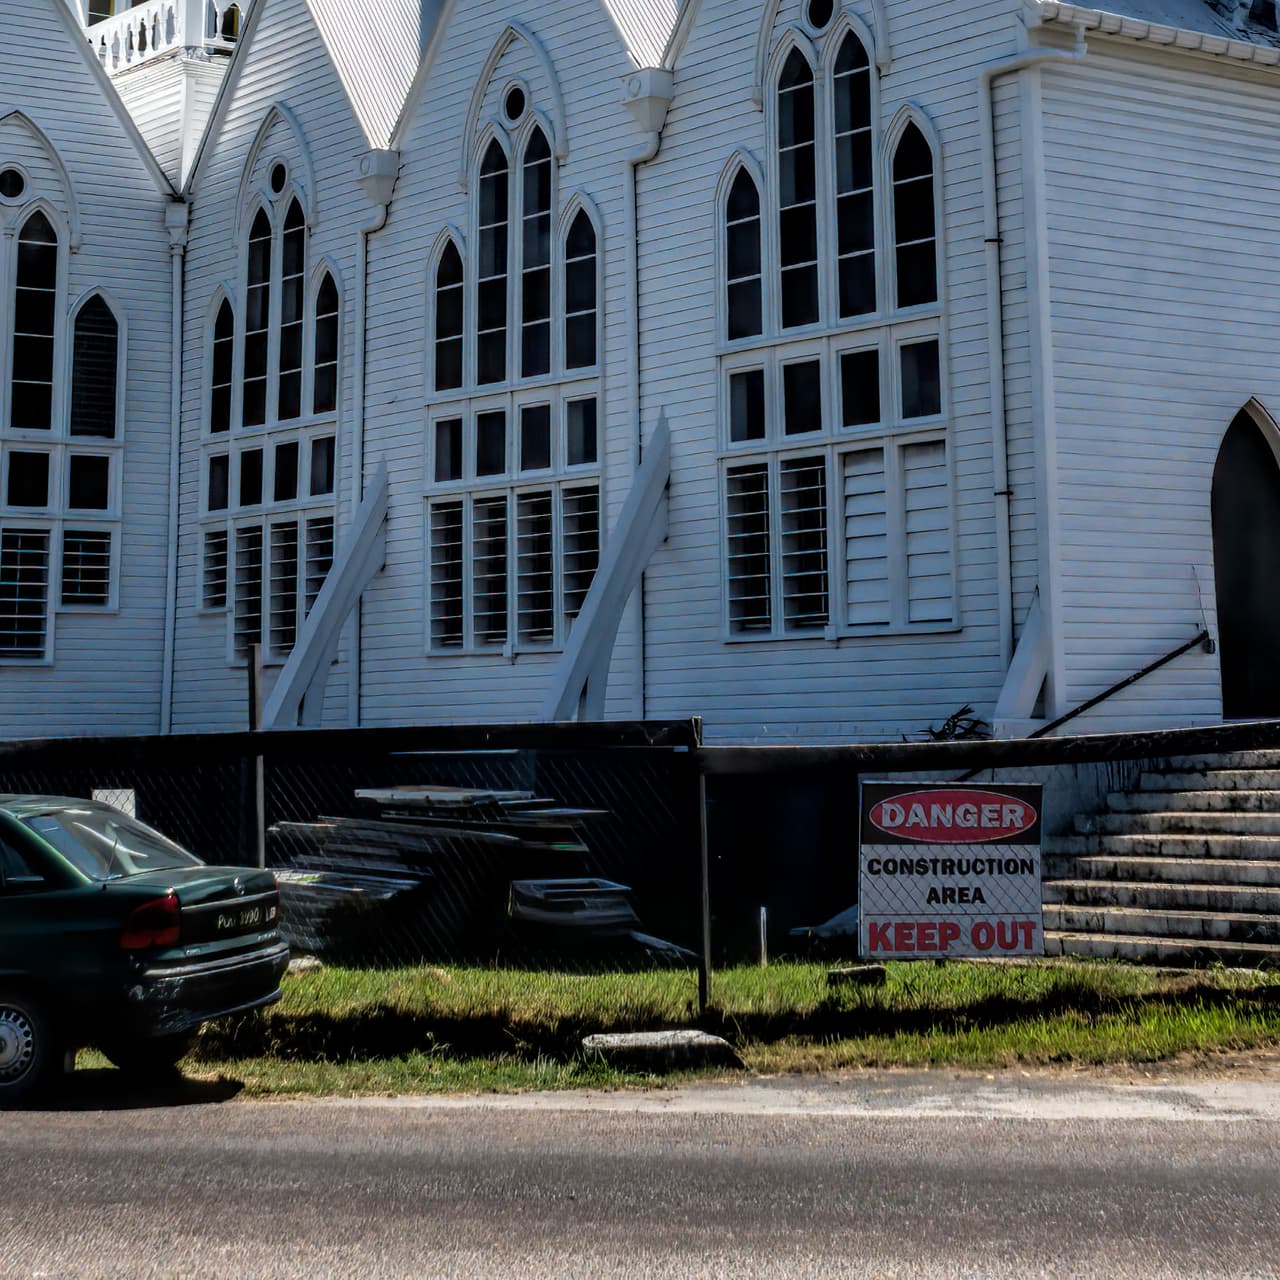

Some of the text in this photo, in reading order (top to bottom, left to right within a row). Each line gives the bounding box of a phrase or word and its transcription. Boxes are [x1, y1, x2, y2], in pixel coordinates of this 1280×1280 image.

[881, 803, 1025, 828] DANGER
[867, 858, 1034, 875] CONSTRUCTION
[926, 886, 987, 905] AREA
[868, 920, 1037, 952] KEEP OUT
